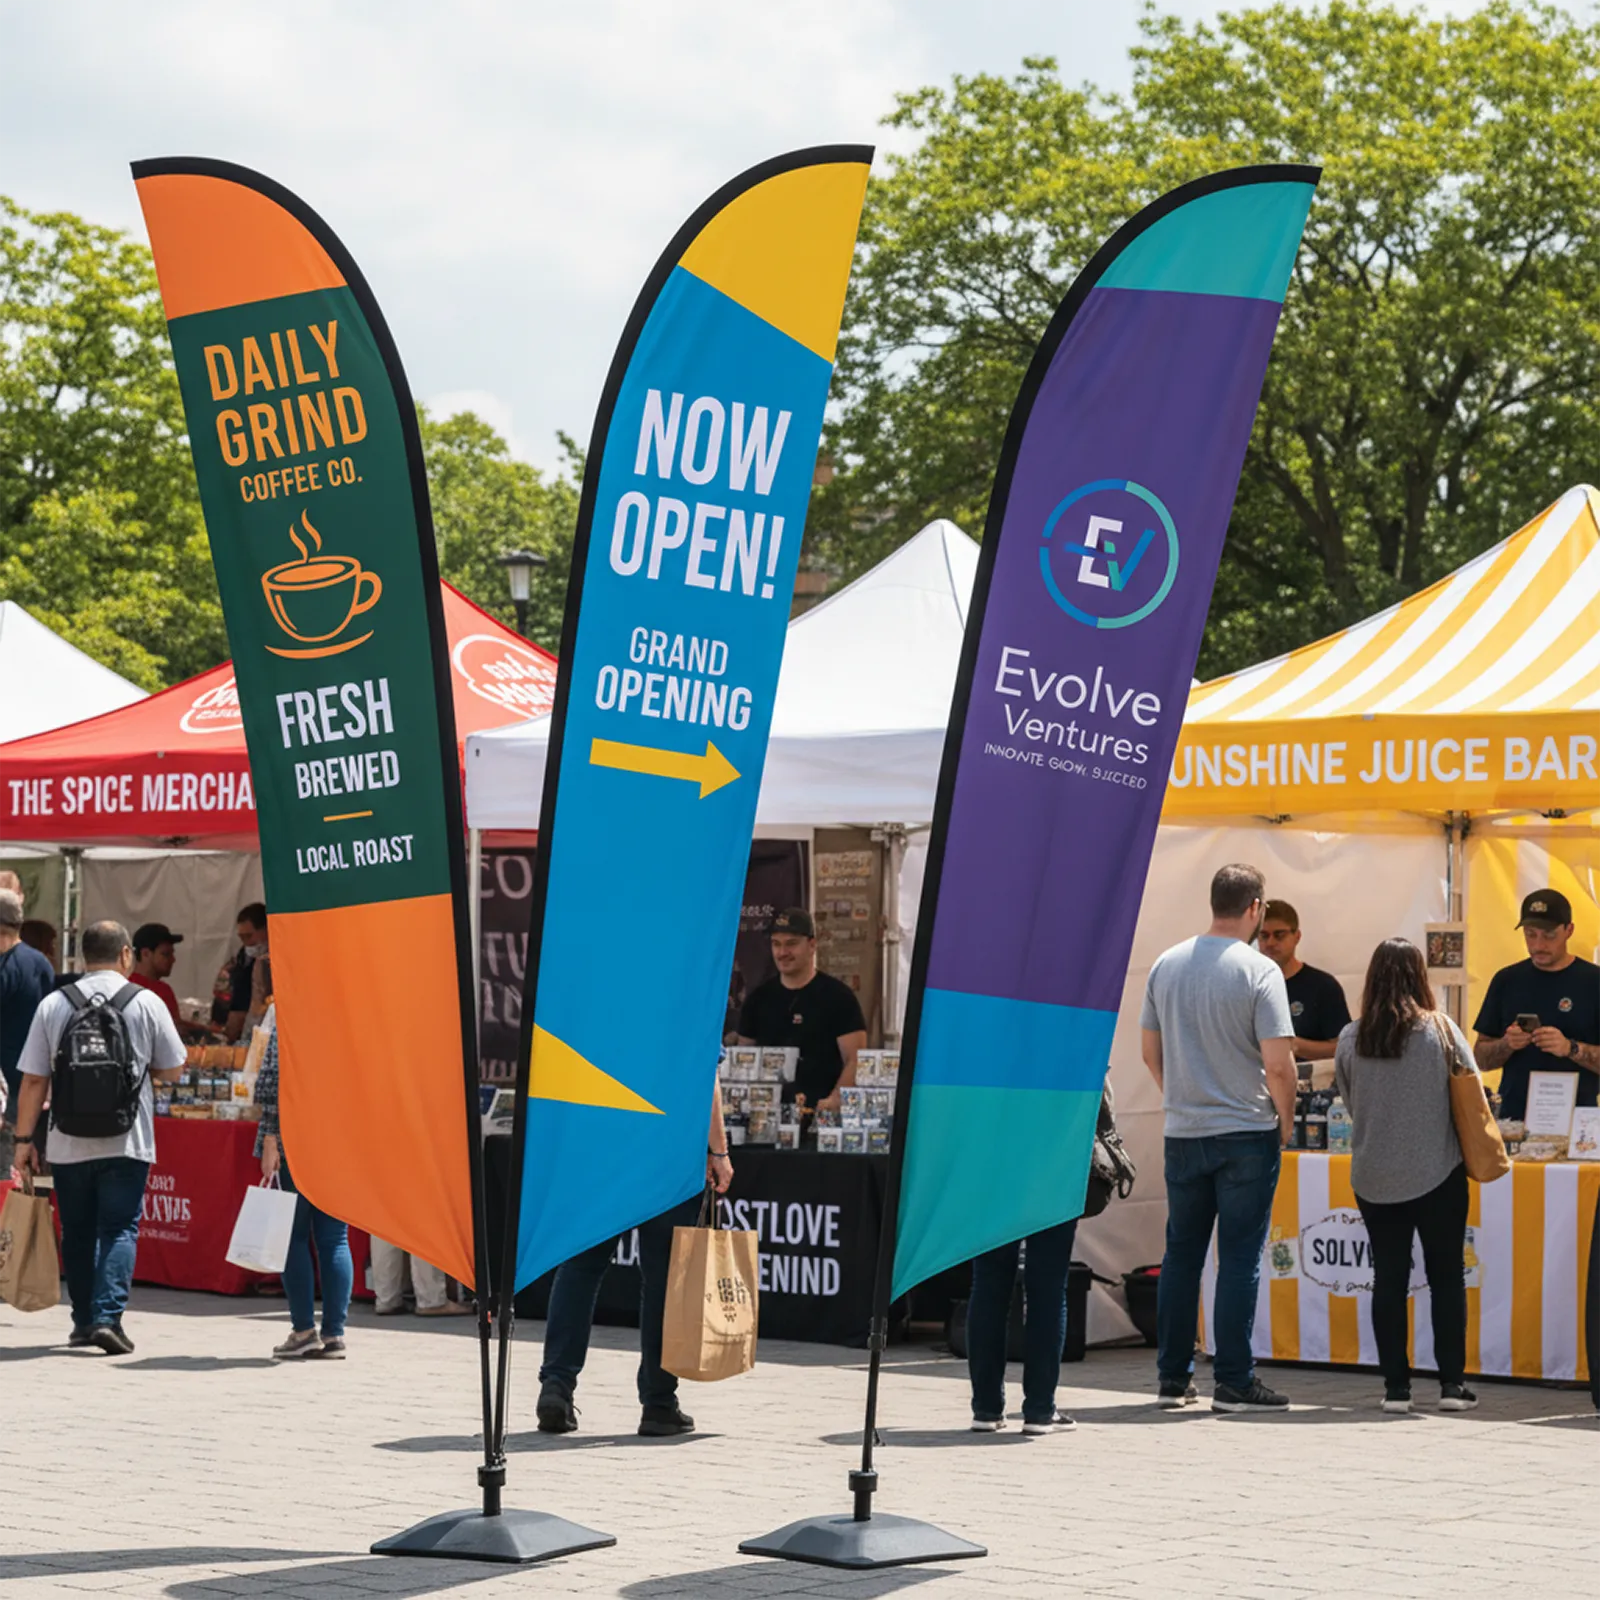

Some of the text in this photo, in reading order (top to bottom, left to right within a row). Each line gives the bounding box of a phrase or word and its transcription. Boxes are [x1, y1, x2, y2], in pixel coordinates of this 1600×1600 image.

[204, 320, 340, 401] DAILY
[215, 386, 368, 467] GRIND
[633, 388, 792, 496] NOW
[240, 457, 363, 503] COFFEE CO.
[609, 490, 785, 600] OPEN!
[629, 626, 730, 676] GRAND
[275, 677, 394, 749] FRESH
[595, 664, 753, 732] OPENING
[994, 645, 1161, 726] Evolve
[1004, 703, 1149, 765] Ventures
[1359, 737, 1489, 783] JUICE
[1503, 734, 1599, 781] BAR
[8, 779, 54, 816] THE
[61, 774, 134, 815] SPICE
[295, 750, 401, 799] BREWED
[296, 834, 415, 874] LOCAL ROAST
